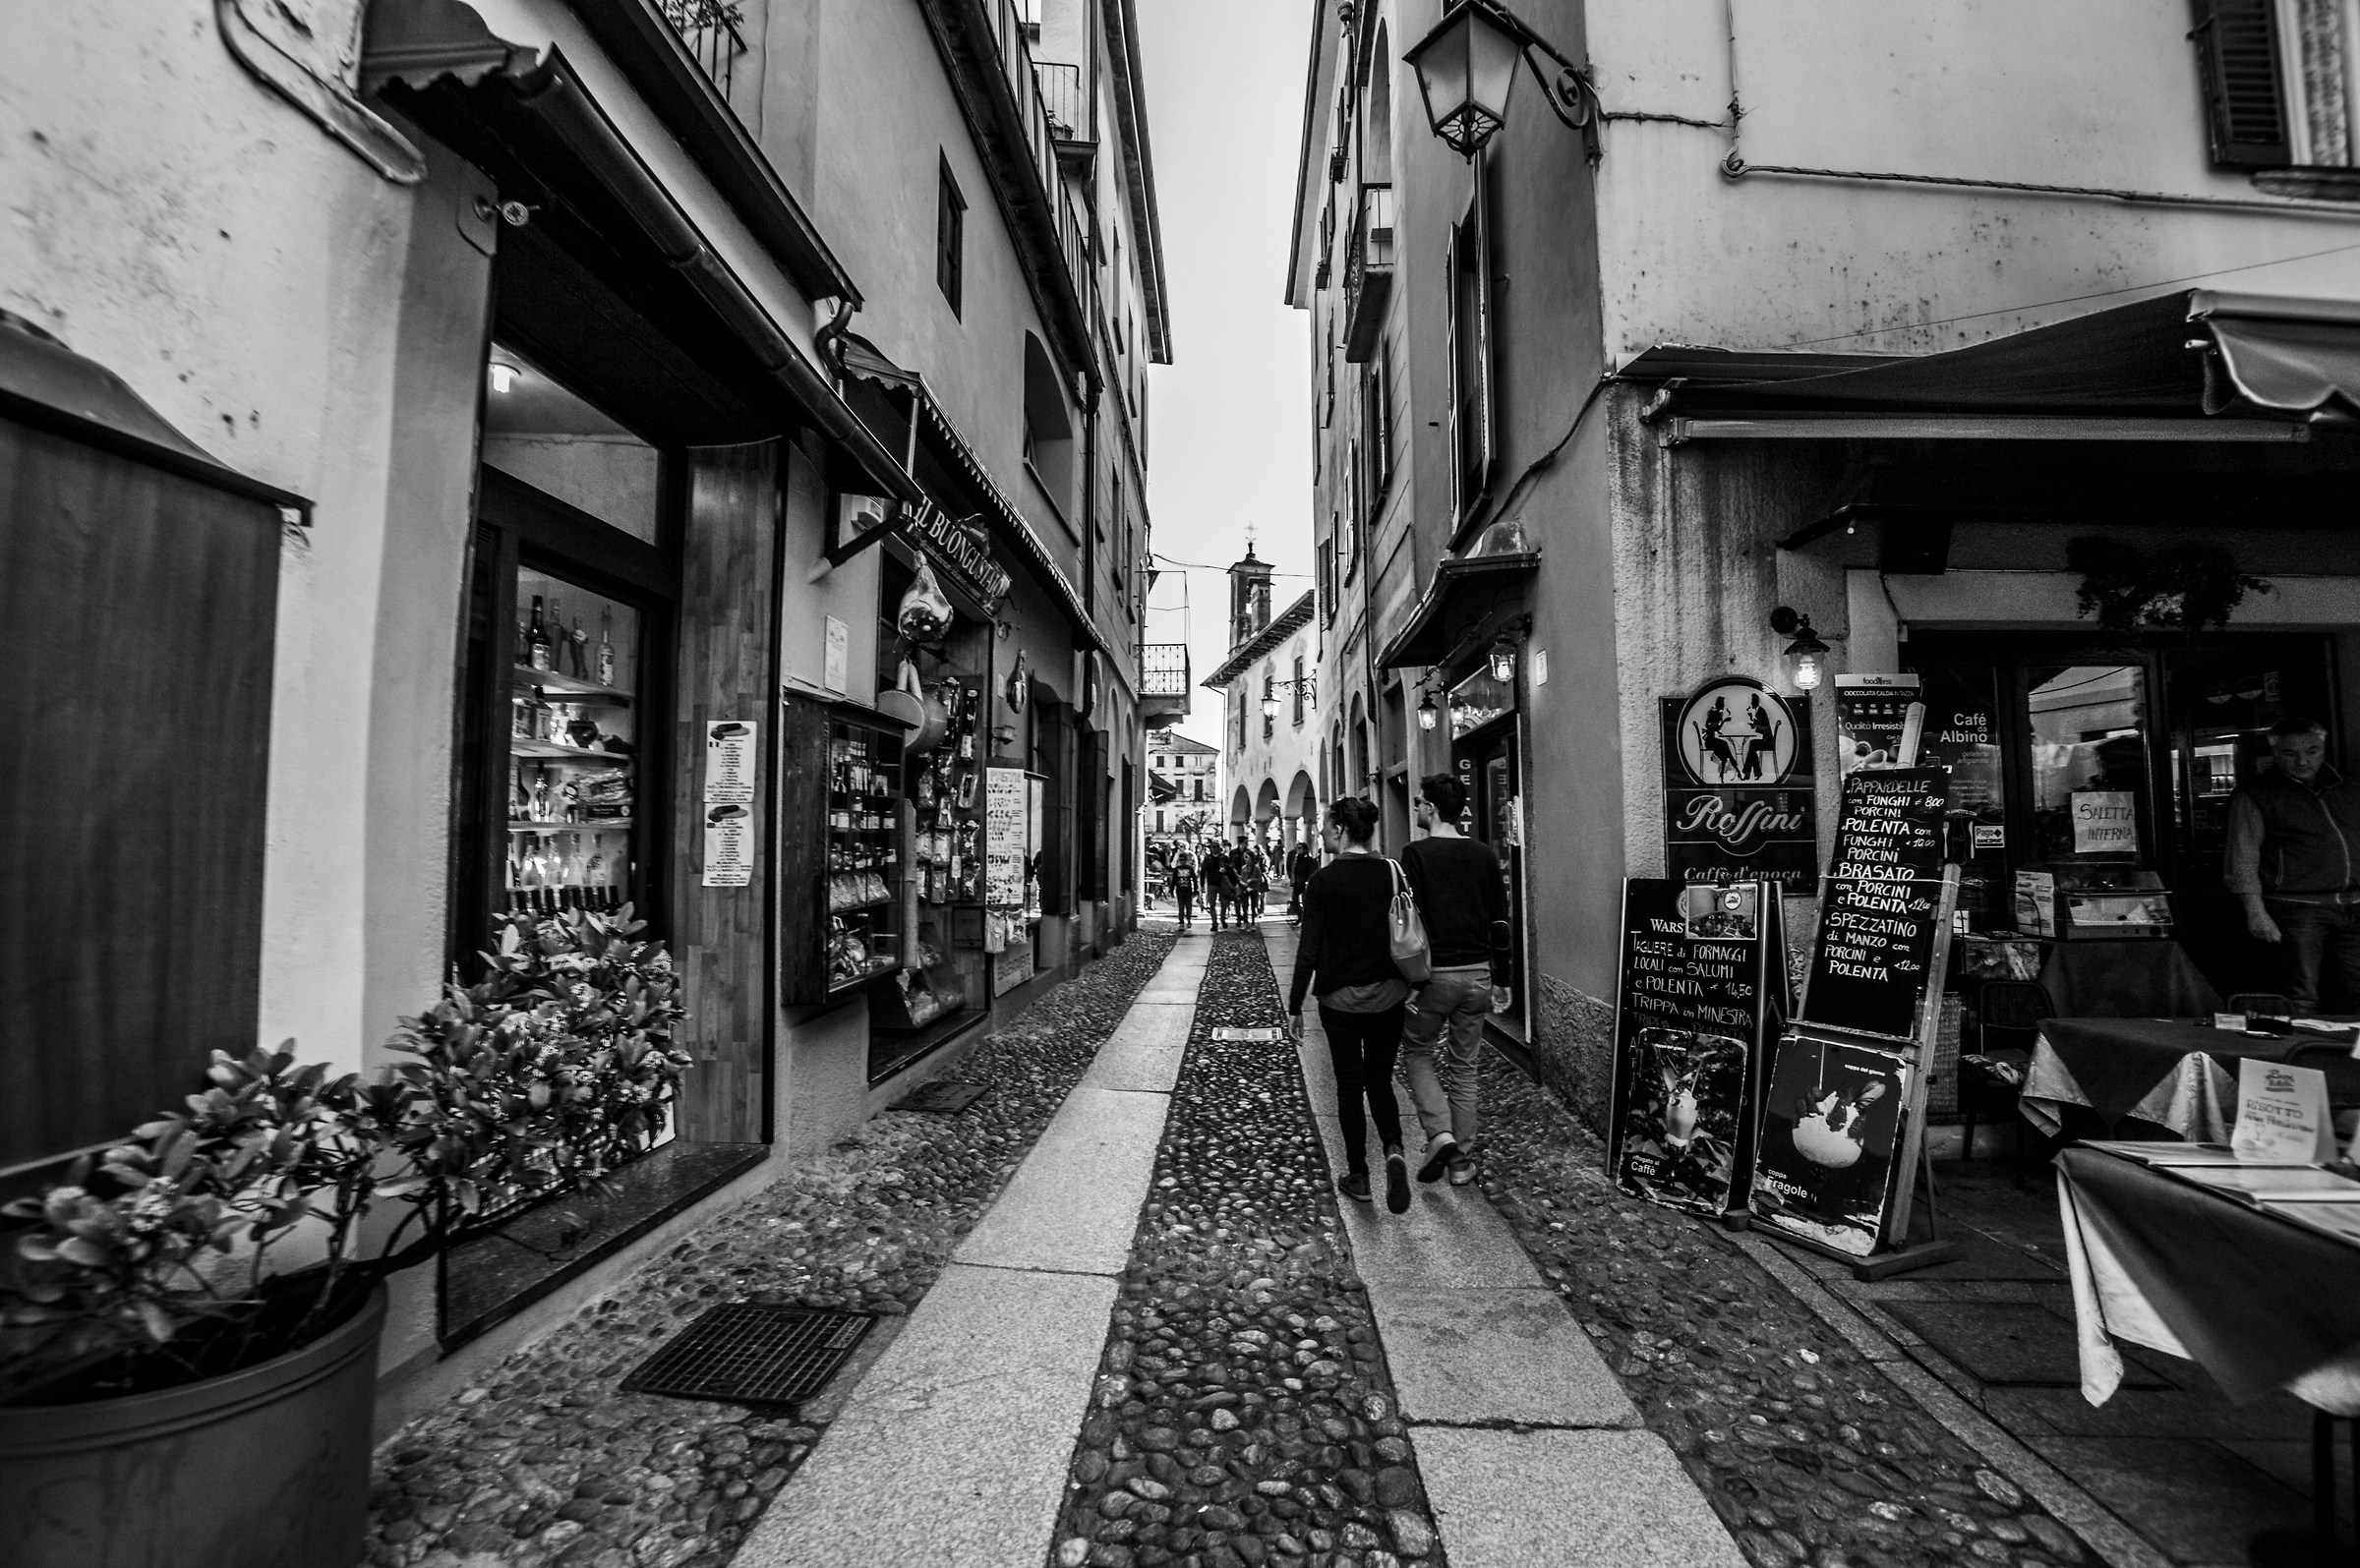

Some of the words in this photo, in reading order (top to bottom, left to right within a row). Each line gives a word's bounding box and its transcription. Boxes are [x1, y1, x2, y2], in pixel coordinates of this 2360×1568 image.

[1872, 722, 1906, 730] Irresistib
[1954, 713, 1987, 726] Café
[1940, 730, 1987, 743] Albino
[1851, 777, 1932, 793] PAPPARDELLE
[1866, 794, 1911, 806] FUNGHI
[1676, 794, 1805, 844] Rossini
[1854, 806, 1902, 818] PORCINI
[2078, 803, 2134, 821] SALETTA
[1845, 818, 1911, 835] POLENTA
[1976, 828, 1994, 839] Pago
[2088, 826, 2135, 841] INTERNA
[1843, 834, 1894, 847] FUNGHI
[1847, 846, 1900, 863] PORCINI
[1839, 862, 1915, 882] BRASATO
[1835, 883, 1853, 892] con
[1857, 880, 1912, 900] PORCINI
[1837, 896, 1846, 904] e
[1847, 892, 1908, 914] POLENTA
[1650, 918, 1684, 934] WARS
[1830, 912, 1918, 938] SPEZZATINO
[1630, 930, 1674, 957] TAGLIERE
[1677, 947, 1686, 958] di
[1693, 944, 1746, 962] FORMAGGI
[1826, 930, 1839, 941] di
[1845, 932, 1888, 948] MANZO
[1824, 944, 1867, 961] PORCINI
[1634, 957, 1665, 971] LOCALI
[1686, 961, 1734, 978] SALUMI
[1829, 959, 1889, 982] POLENTA
[1635, 979, 1643, 989] e
[1646, 975, 1704, 997] POLENTA
[1725, 981, 1753, 999] 14,50
[1632, 992, 1680, 1015] TRIPPA
[1682, 1007, 1694, 1017] in
[1697, 1004, 1753, 1028] MINESTRA
[2246, 1099, 2304, 1120] RISOTTO
[1630, 1161, 1656, 1176] Caffè
[1768, 1169, 1788, 1179] coppa
[1767, 1175, 1807, 1198] Fragole
